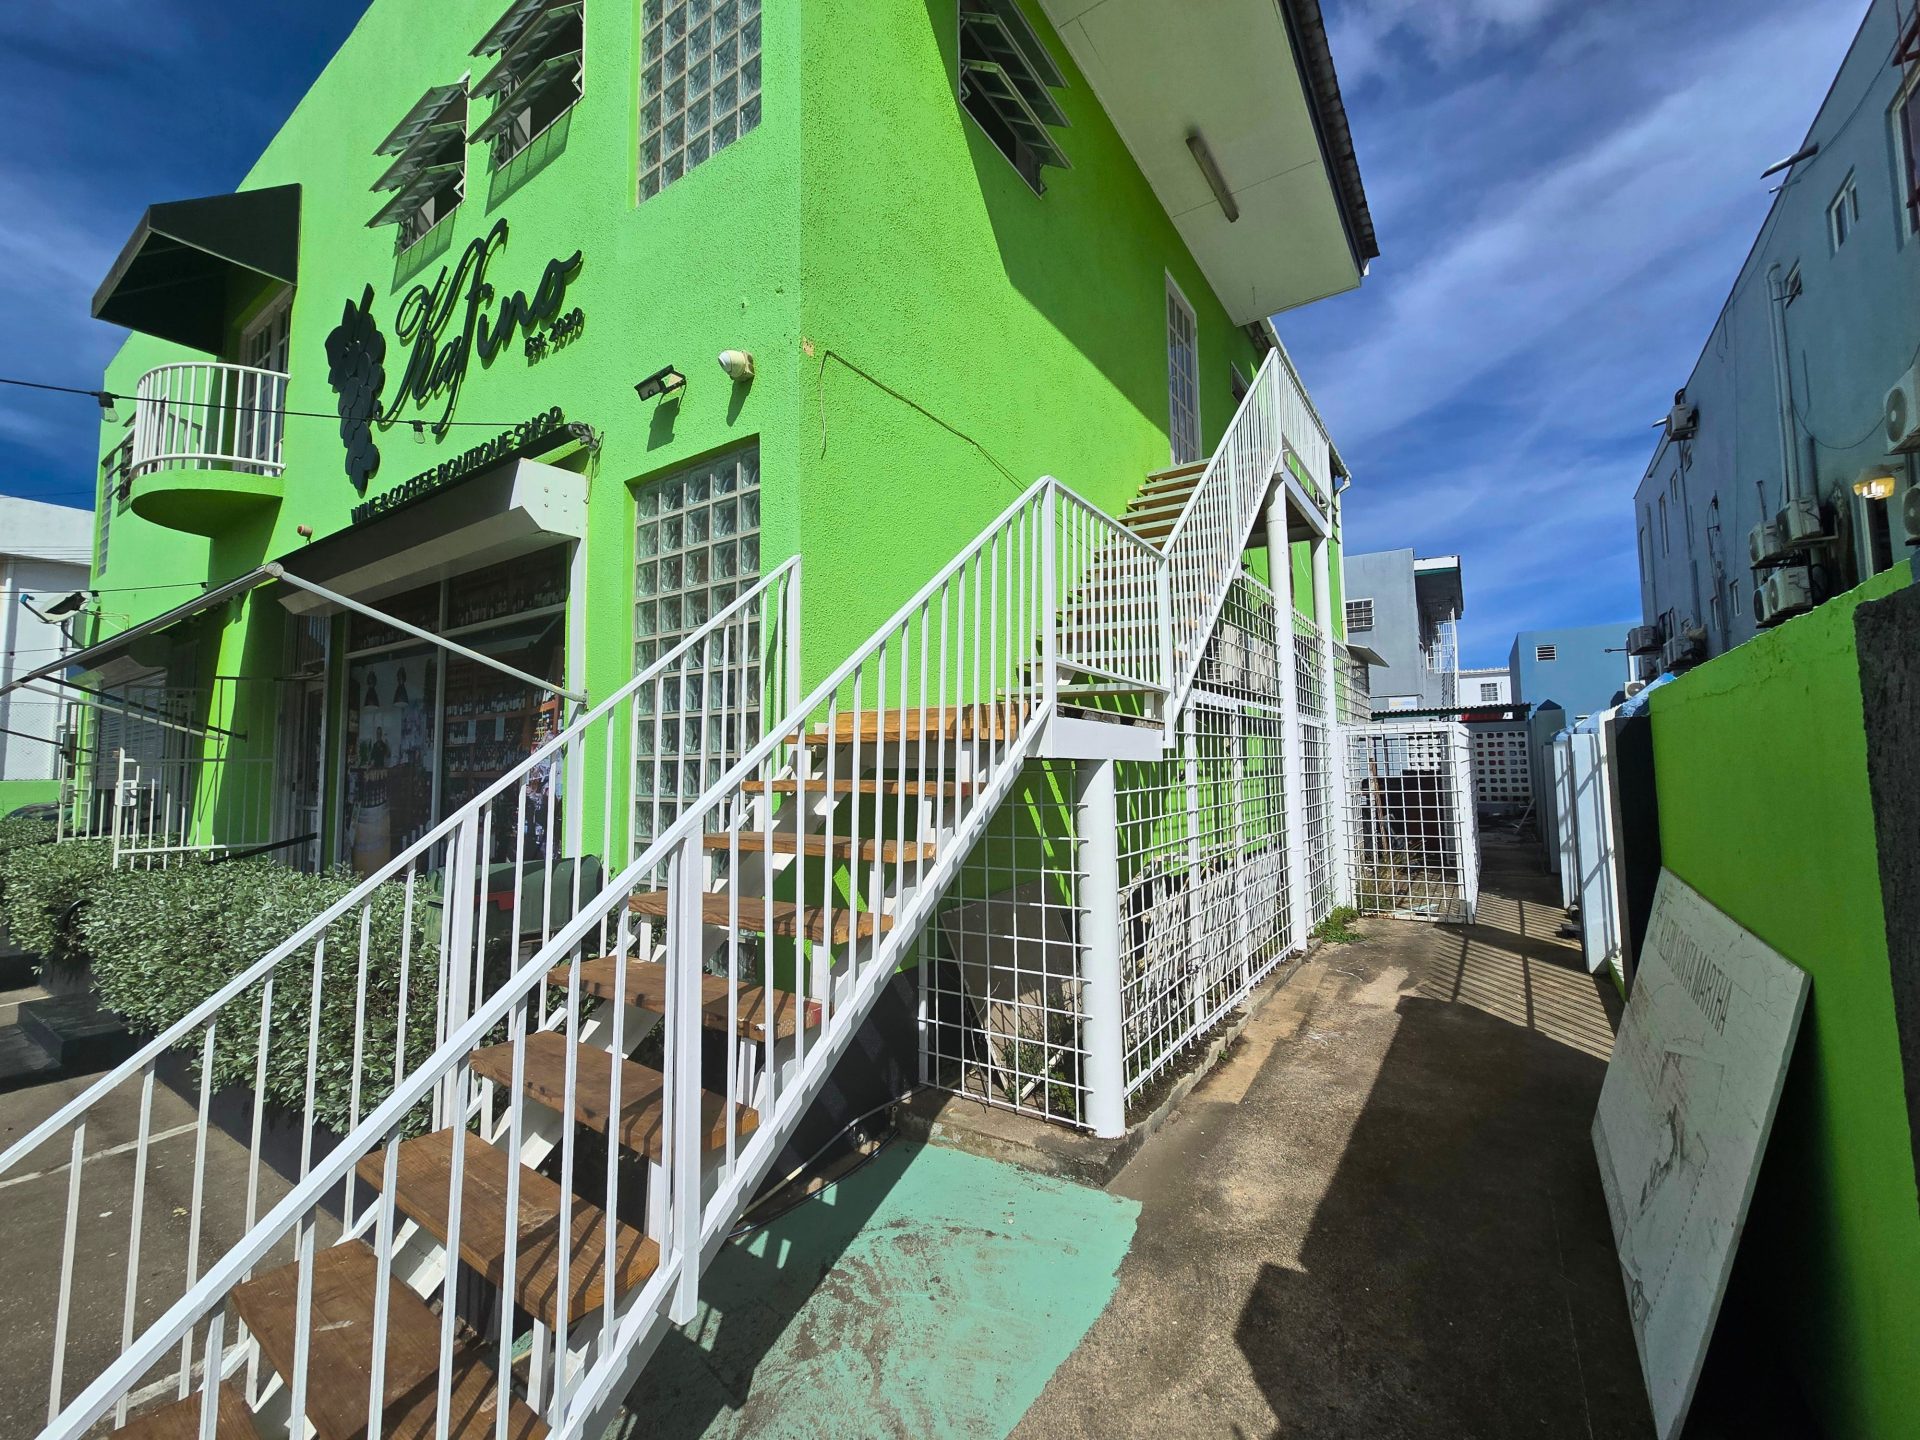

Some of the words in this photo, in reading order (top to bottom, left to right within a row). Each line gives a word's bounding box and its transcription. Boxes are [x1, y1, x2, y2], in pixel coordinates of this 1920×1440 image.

[351, 496, 382, 523] WINE
[388, 467, 438, 503] COFFEE
[437, 430, 514, 486] BOUTIQUE
[513, 405, 563, 446] SHOP
[1691, 950, 1733, 1037] MARTHA
